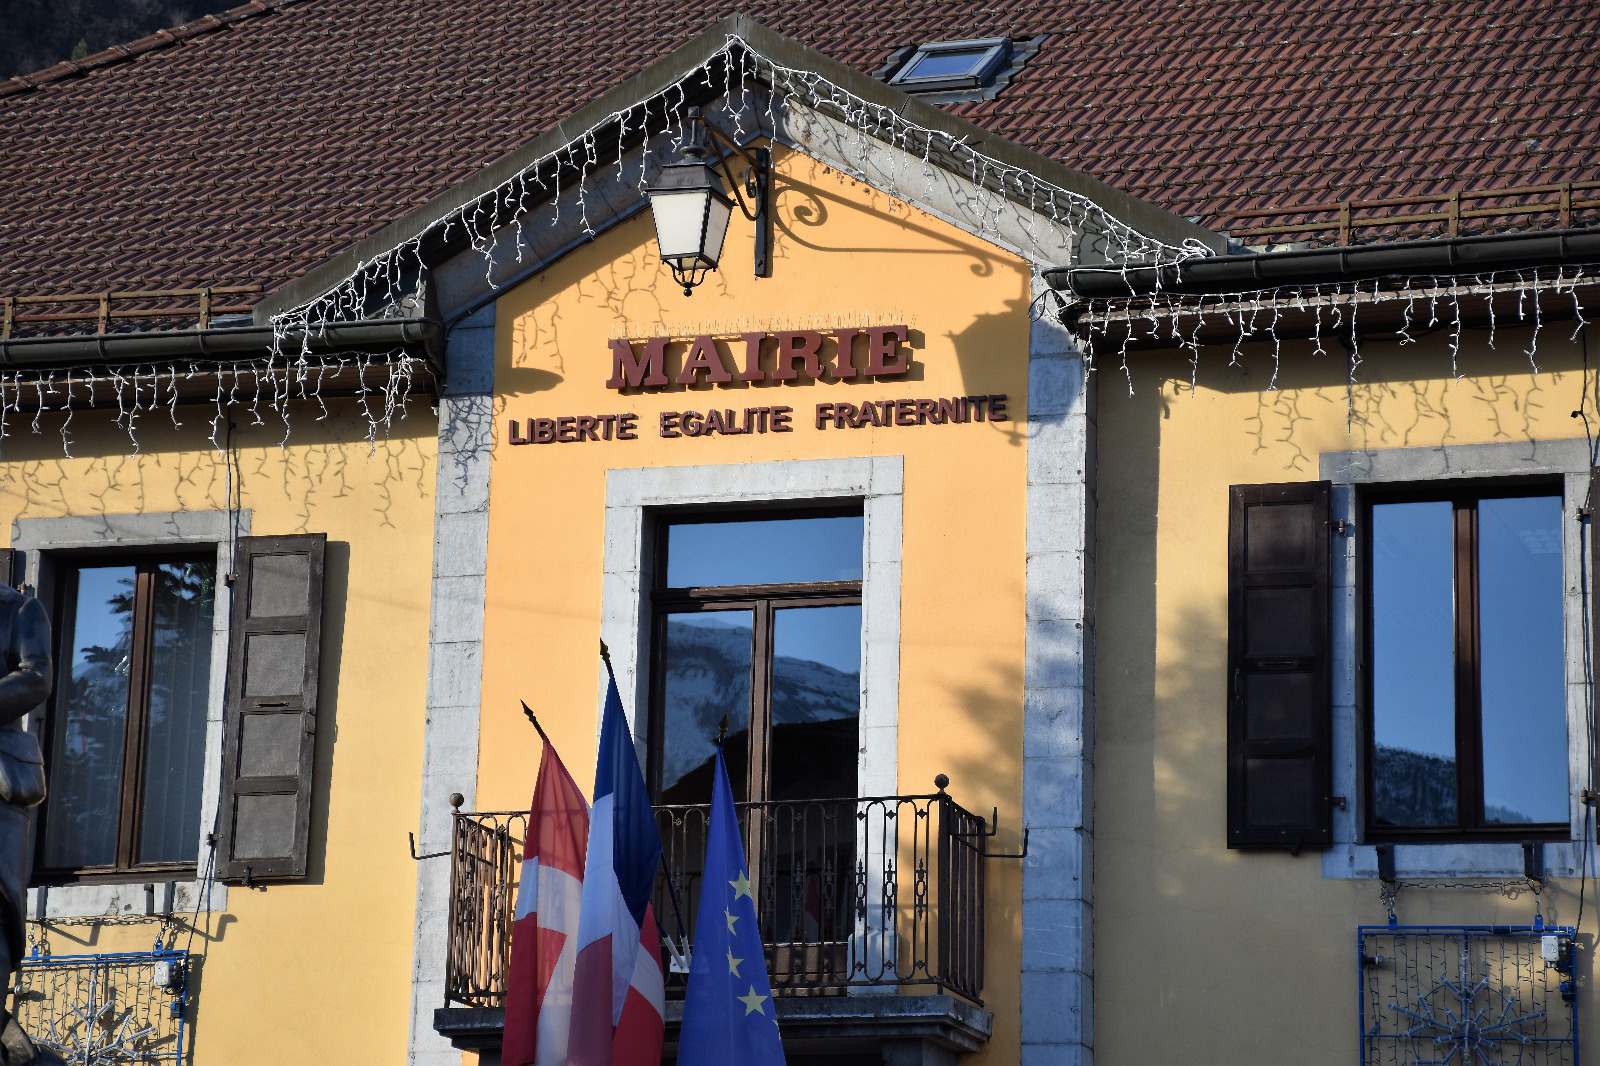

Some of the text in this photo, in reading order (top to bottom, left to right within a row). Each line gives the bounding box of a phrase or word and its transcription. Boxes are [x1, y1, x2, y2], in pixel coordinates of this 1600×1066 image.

[606, 325, 909, 390] MAIRIE
[508, 394, 1008, 445] LIBERTE EGALITE FRATERNITE
